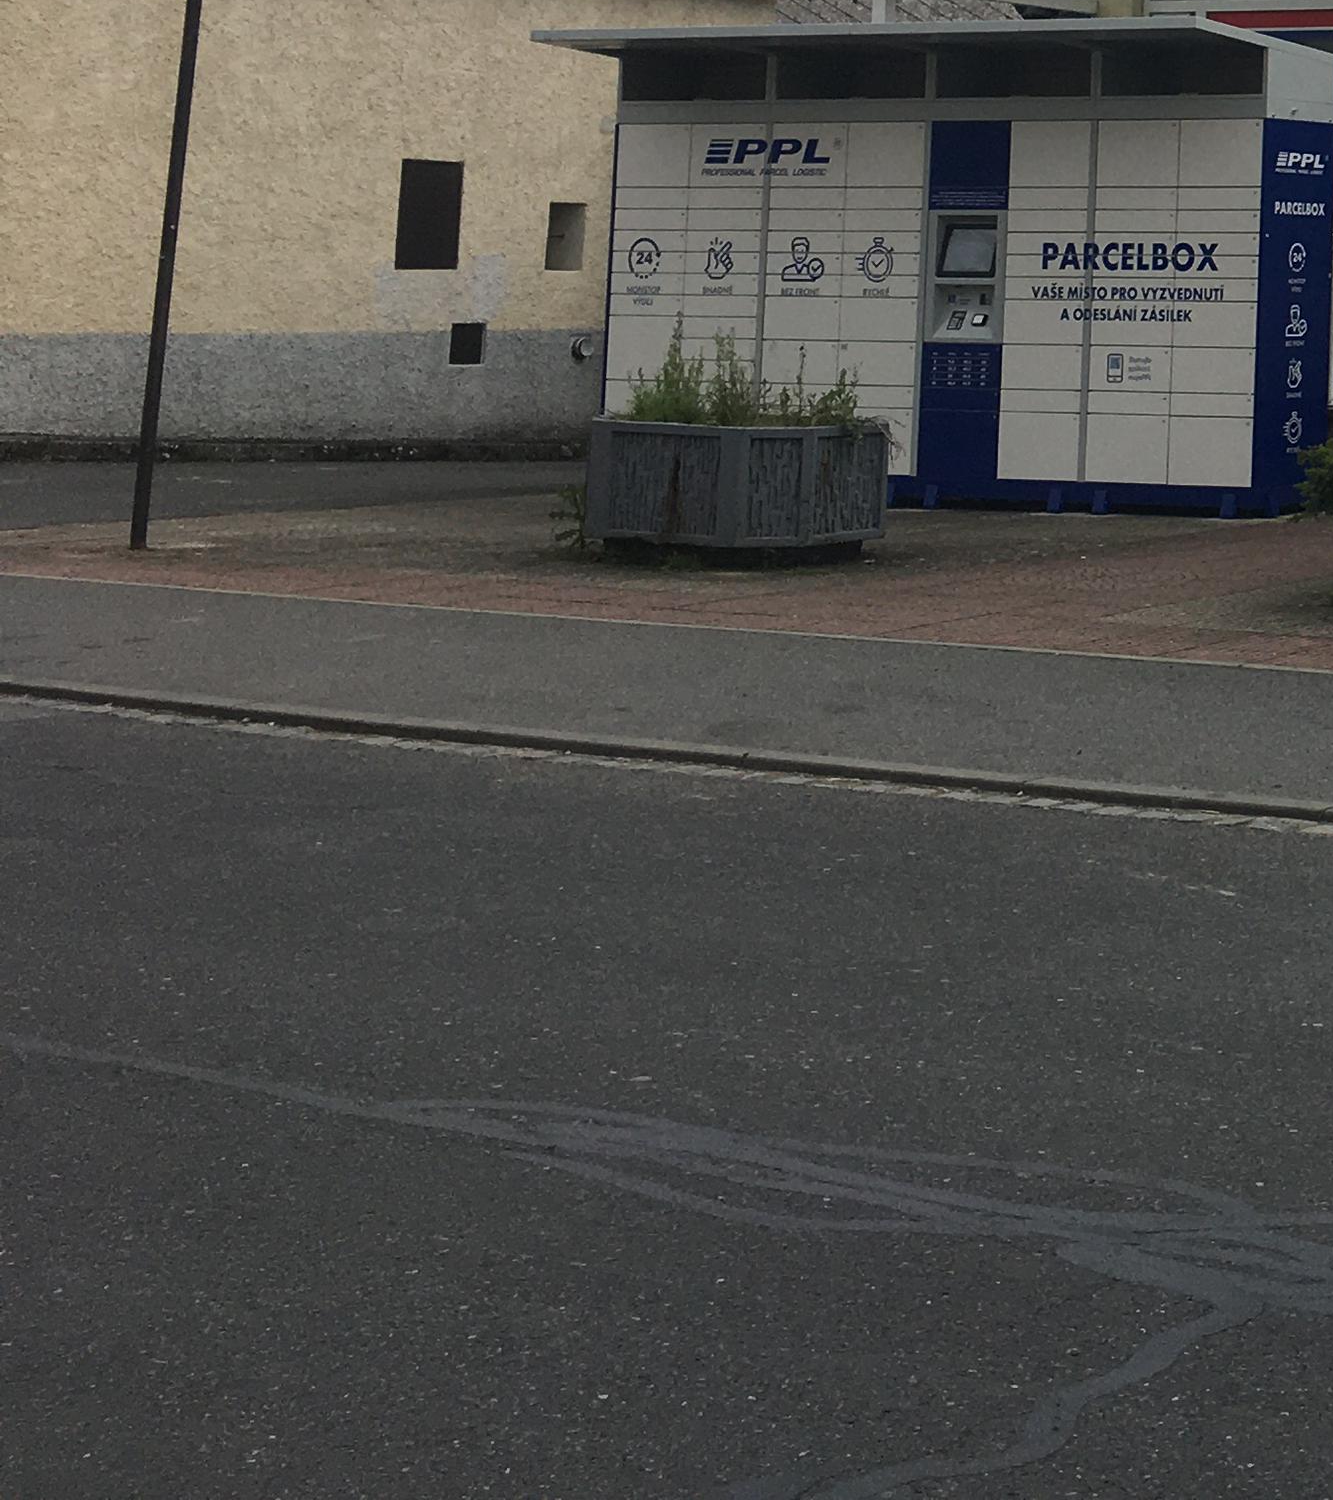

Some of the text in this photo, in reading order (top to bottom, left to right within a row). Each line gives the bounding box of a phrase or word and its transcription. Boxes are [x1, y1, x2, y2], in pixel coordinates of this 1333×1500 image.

[733, 138, 831, 165] PPL
[1287, 152, 1325, 169] PPL
[1274, 201, 1326, 216] PARCELBOX
[636, 252, 653, 265] 24
[1041, 242, 1219, 272] PARCELBOX
[1031, 283, 1225, 301] VAŠE MÍSTO PRO VYZVEDNUTÍ
[1060, 305, 1192, 322] A ODESLÁNÍ ZÁSILEK
